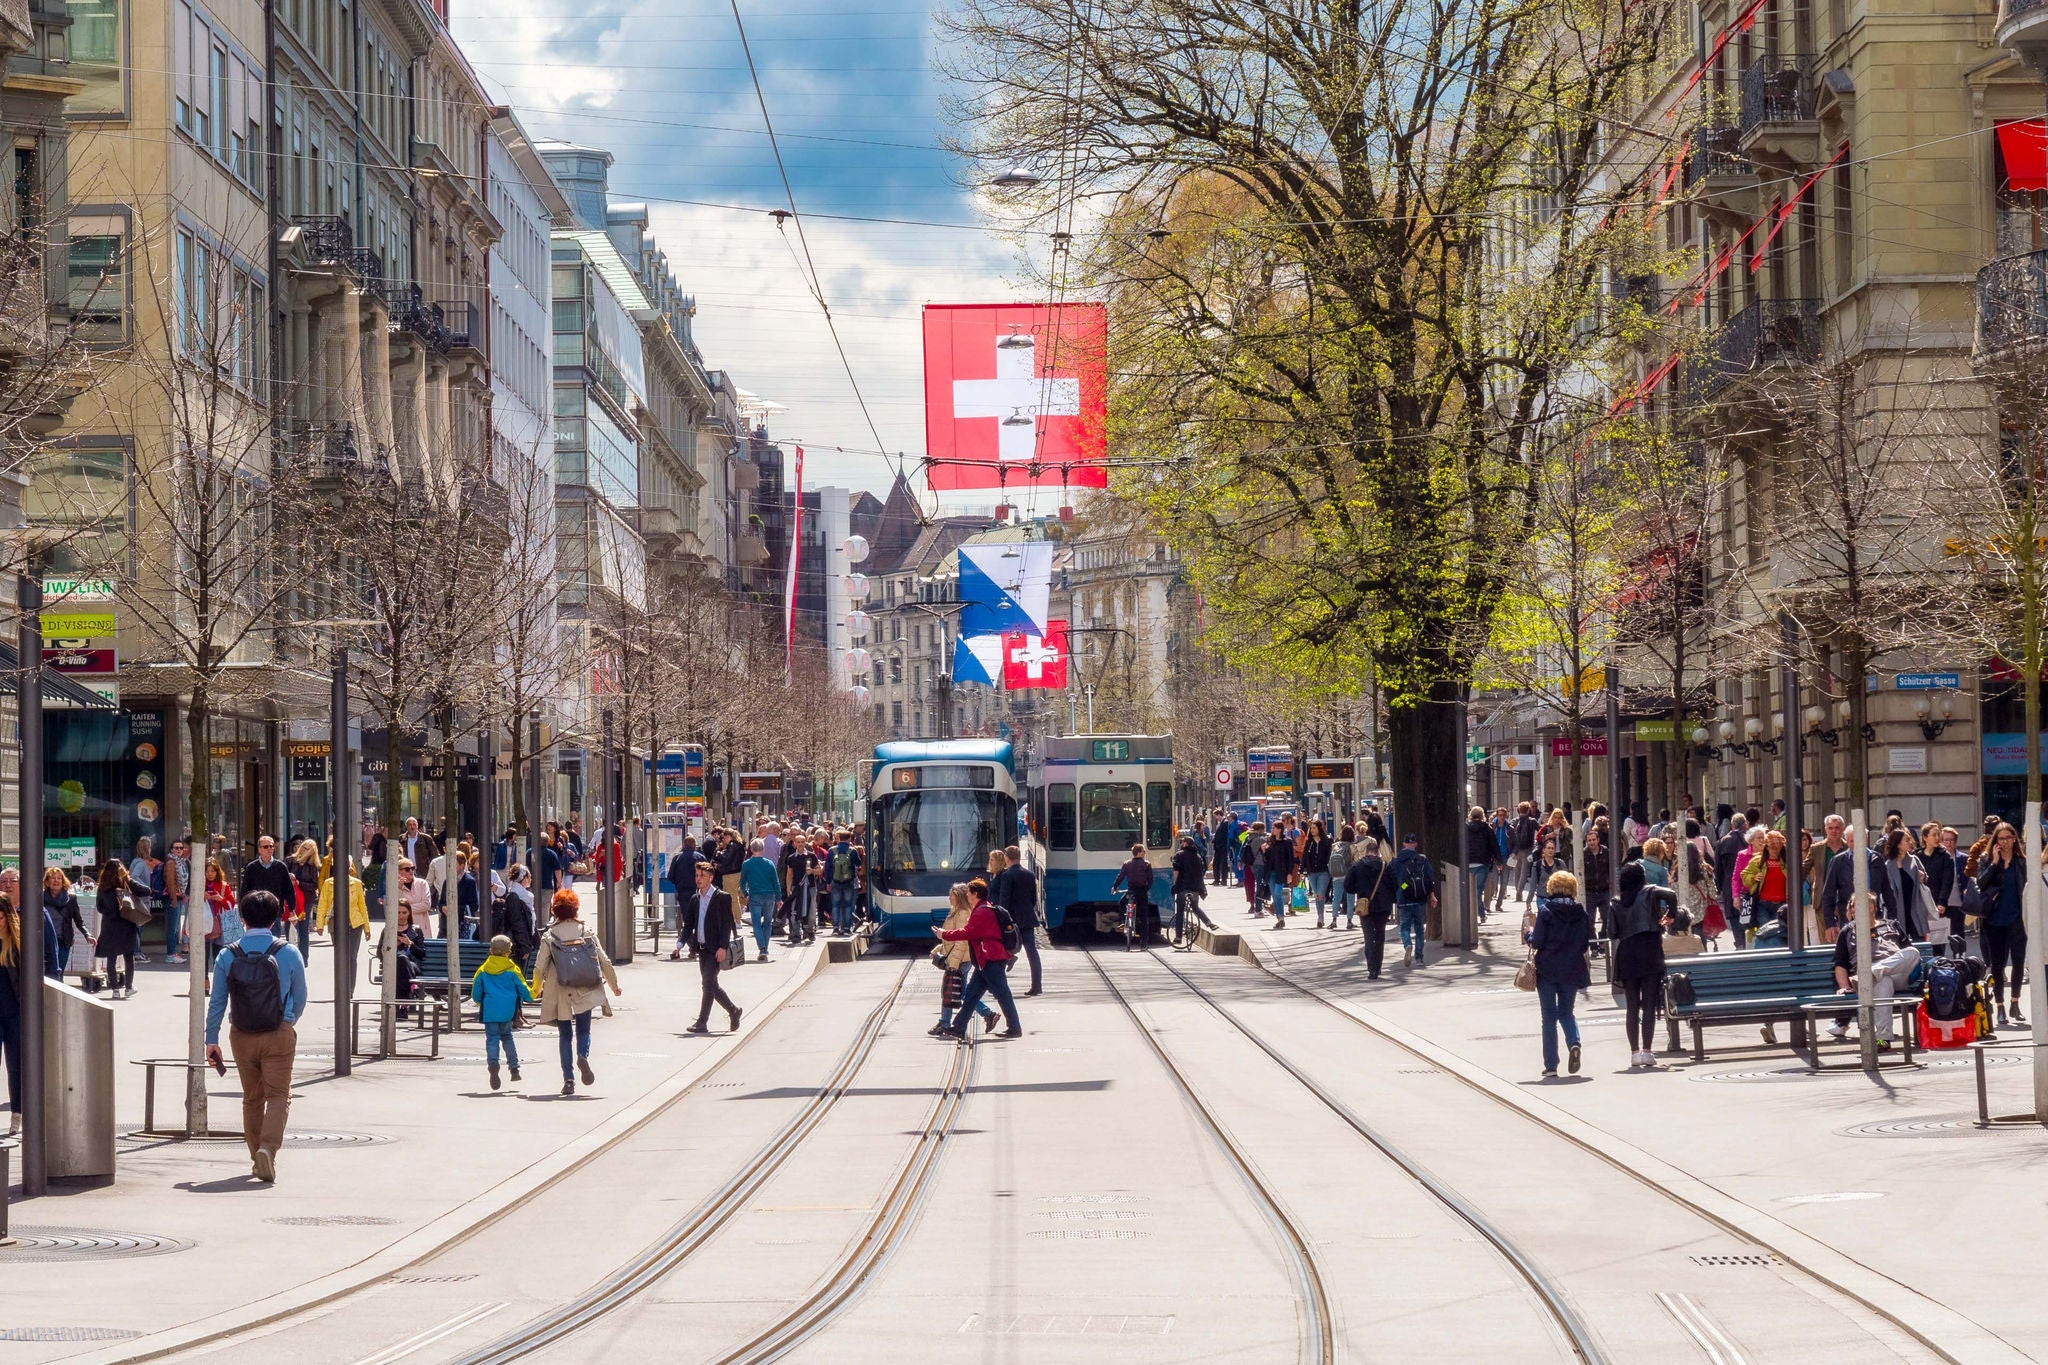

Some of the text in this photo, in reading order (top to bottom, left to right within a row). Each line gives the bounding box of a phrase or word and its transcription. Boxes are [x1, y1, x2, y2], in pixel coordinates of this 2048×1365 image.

[131, 720, 161, 728] RUNNING
[289, 743, 331, 755] yooji's
[1103, 743, 1119, 759] 11
[901, 772, 910, 783] 6
